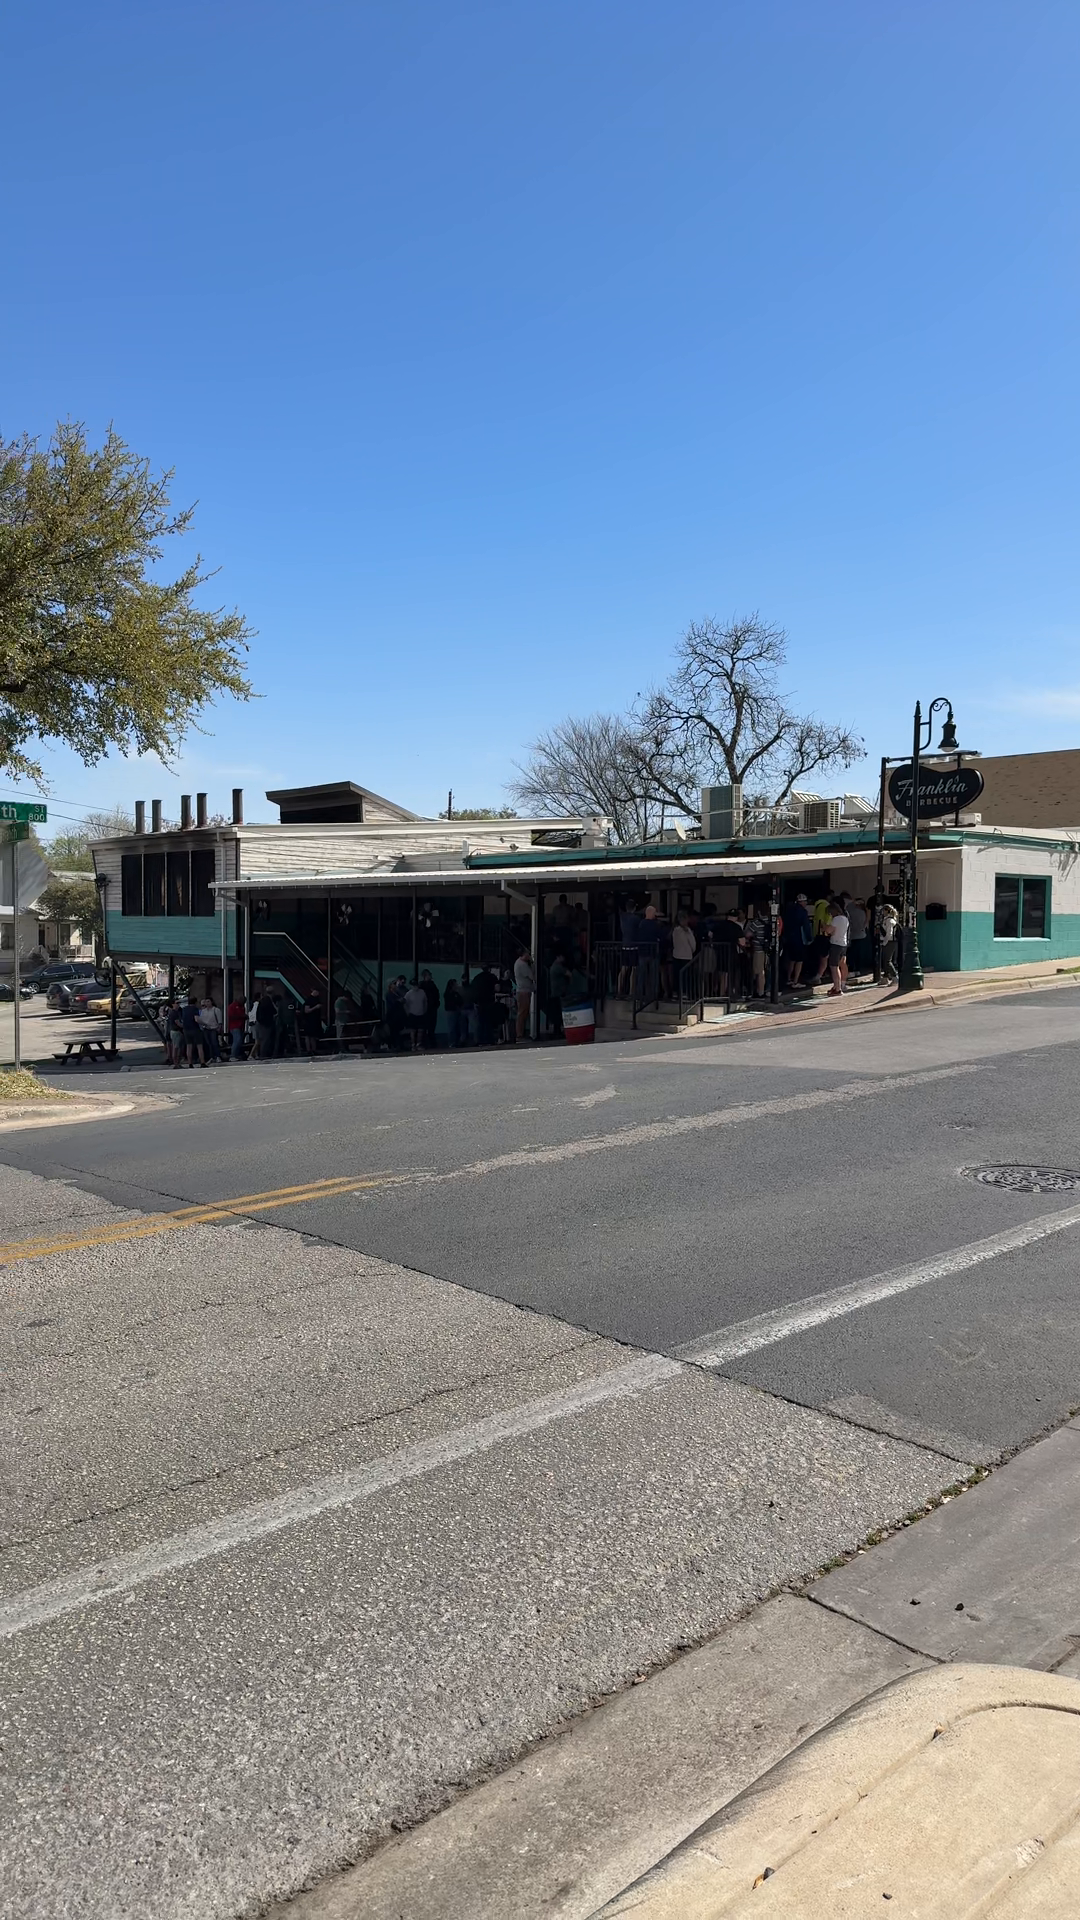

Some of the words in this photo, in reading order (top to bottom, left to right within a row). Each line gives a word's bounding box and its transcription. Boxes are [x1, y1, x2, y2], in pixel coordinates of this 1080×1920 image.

[906, 796, 958, 807] BRBECUE
[34, 805, 45, 813] ST
[28, 813, 45, 821] 800
